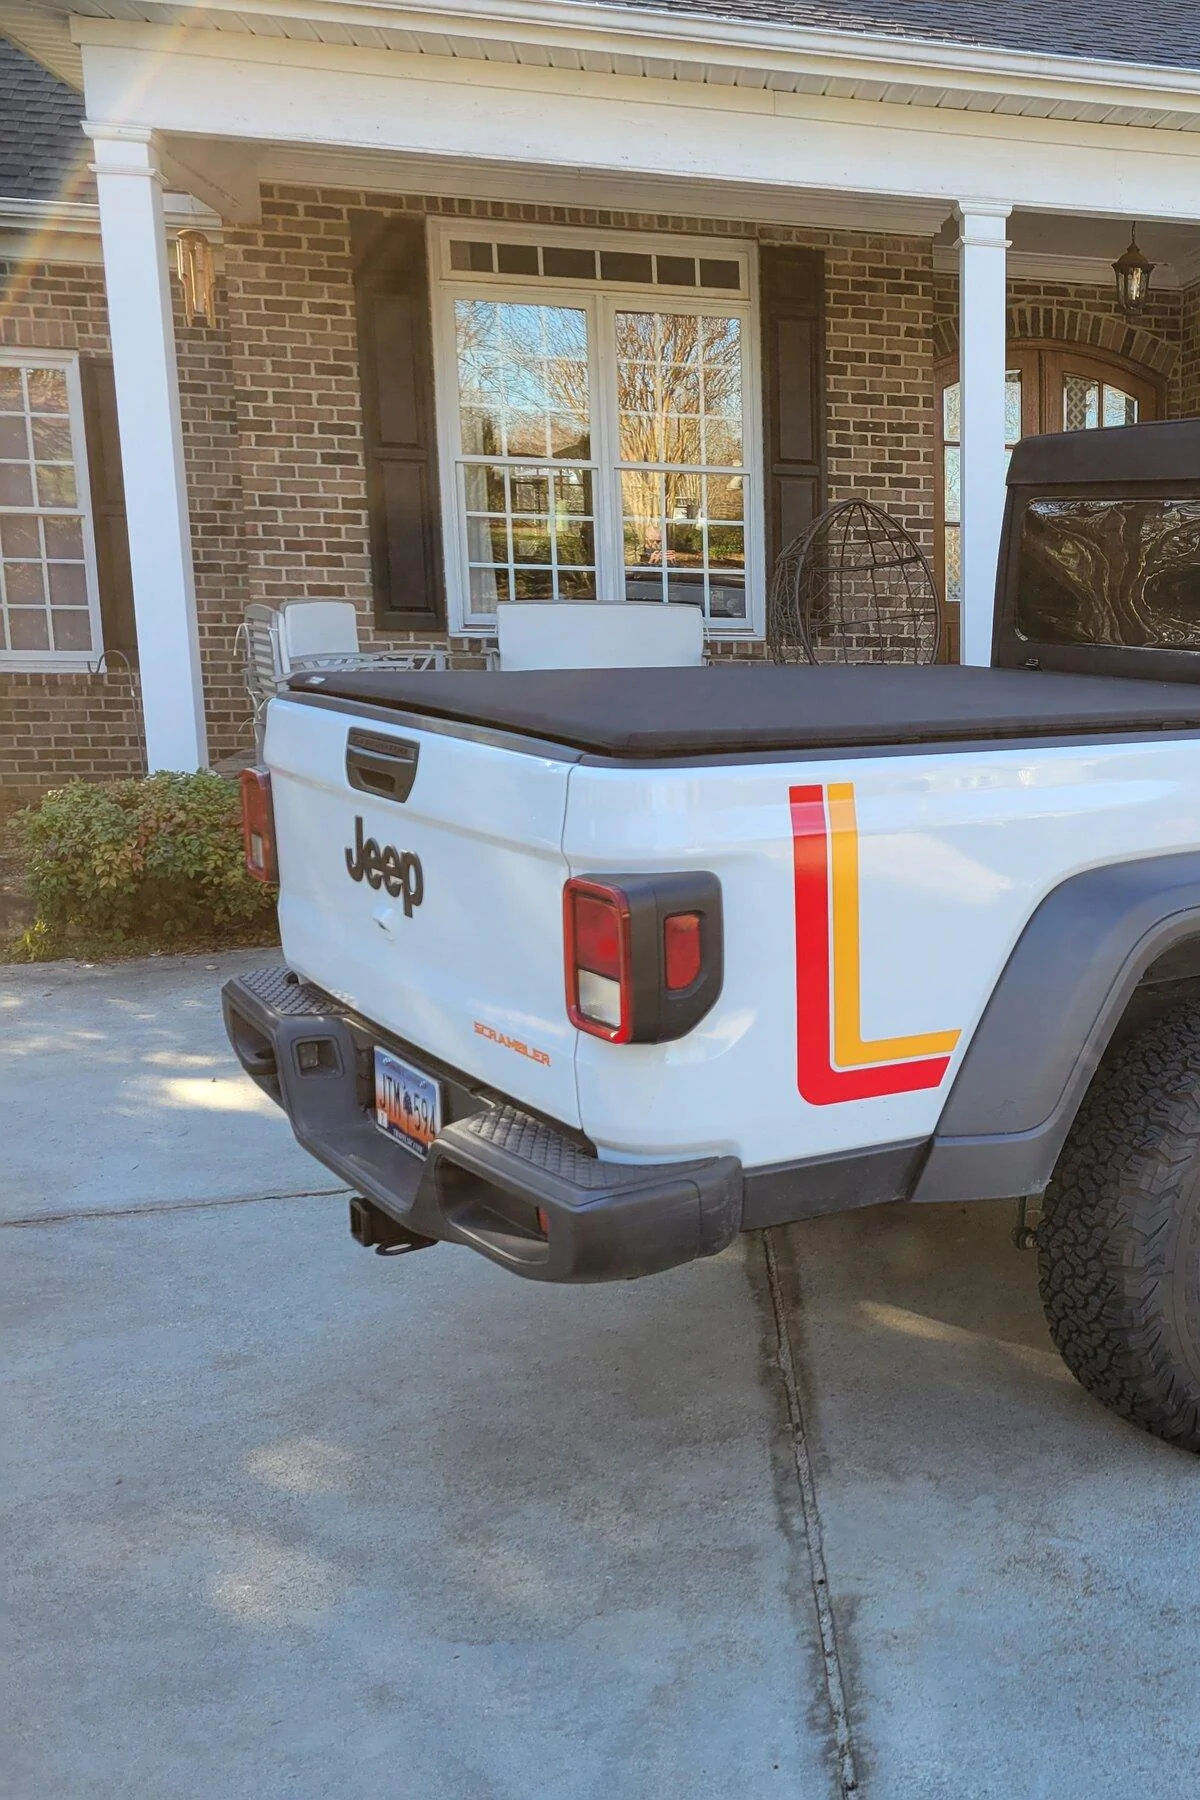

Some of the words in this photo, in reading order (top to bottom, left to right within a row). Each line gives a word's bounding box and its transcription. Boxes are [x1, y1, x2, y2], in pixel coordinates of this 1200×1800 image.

[344, 815, 424, 918] Jeep
[473, 1021, 551, 1067] SCRAMBLER
[379, 1073, 402, 1119] JTM
[413, 1092, 436, 1138] 594
